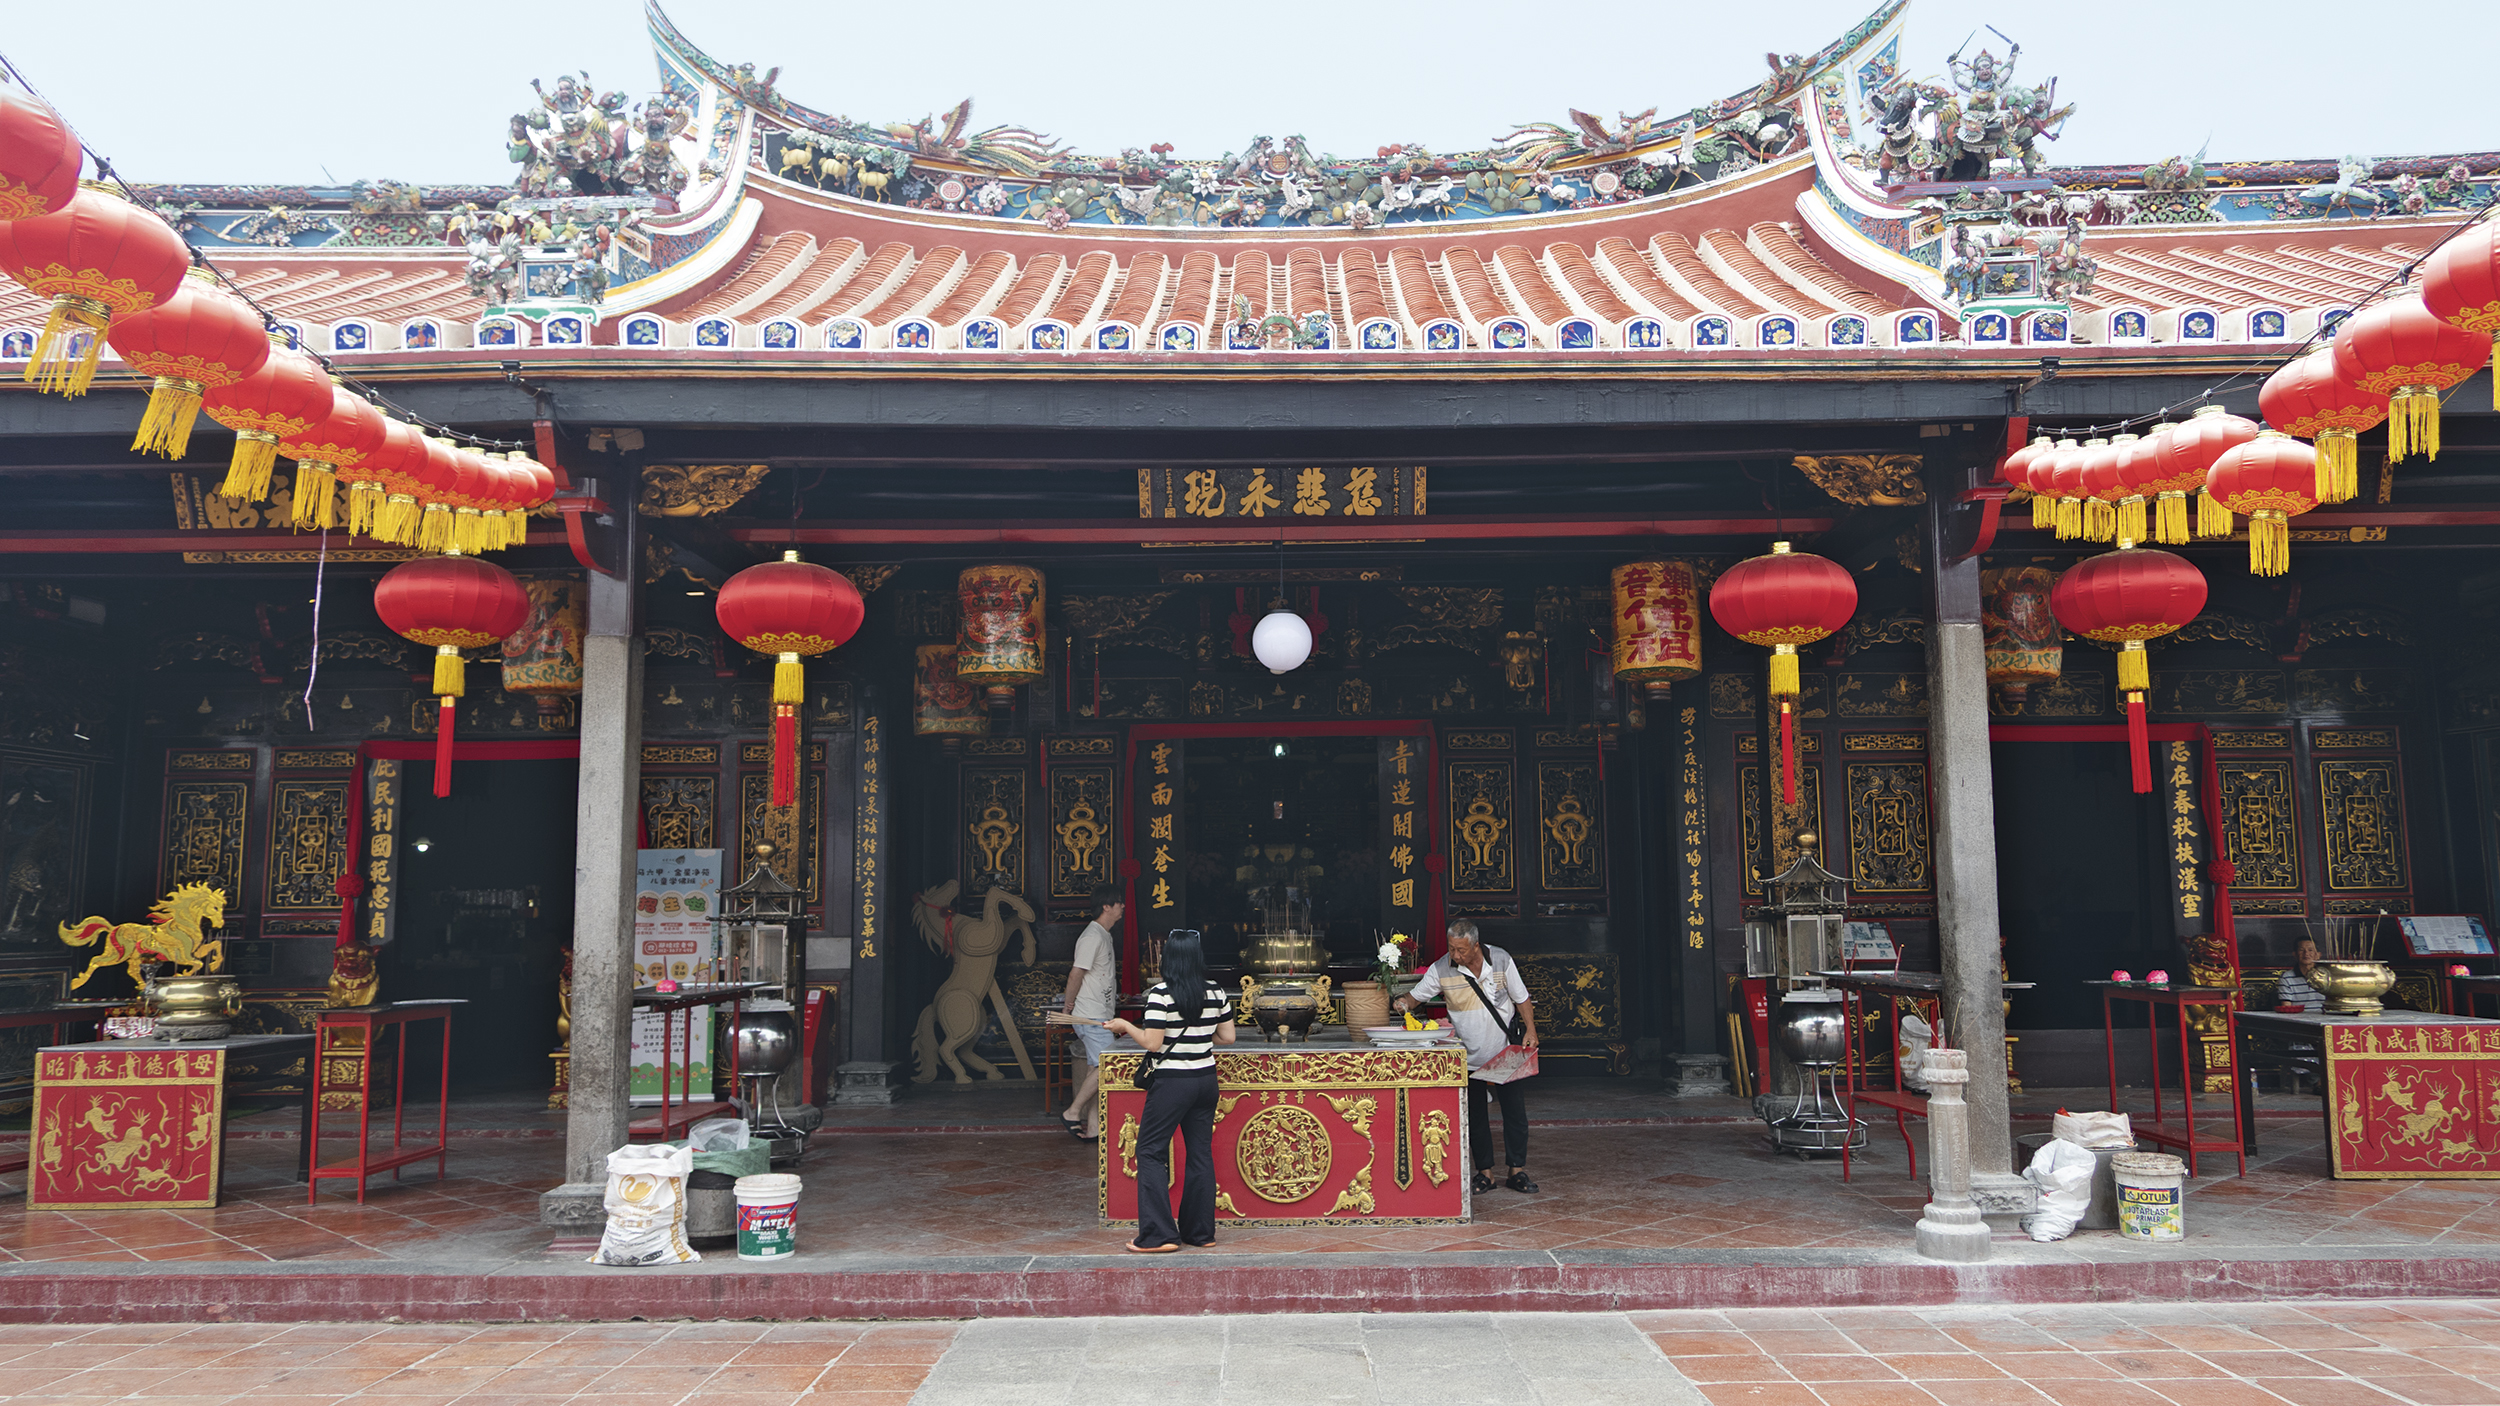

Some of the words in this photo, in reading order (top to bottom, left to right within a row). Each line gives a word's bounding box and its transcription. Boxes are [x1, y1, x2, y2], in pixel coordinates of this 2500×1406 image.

[637, 895, 706, 914] 招生啦
[2135, 1192, 2169, 1202] JOTUN
[2128, 1206, 2169, 1216] JOTAPLAST
[749, 1217, 791, 1231] MATEX
[2136, 1215, 2161, 1223] PRIMER
